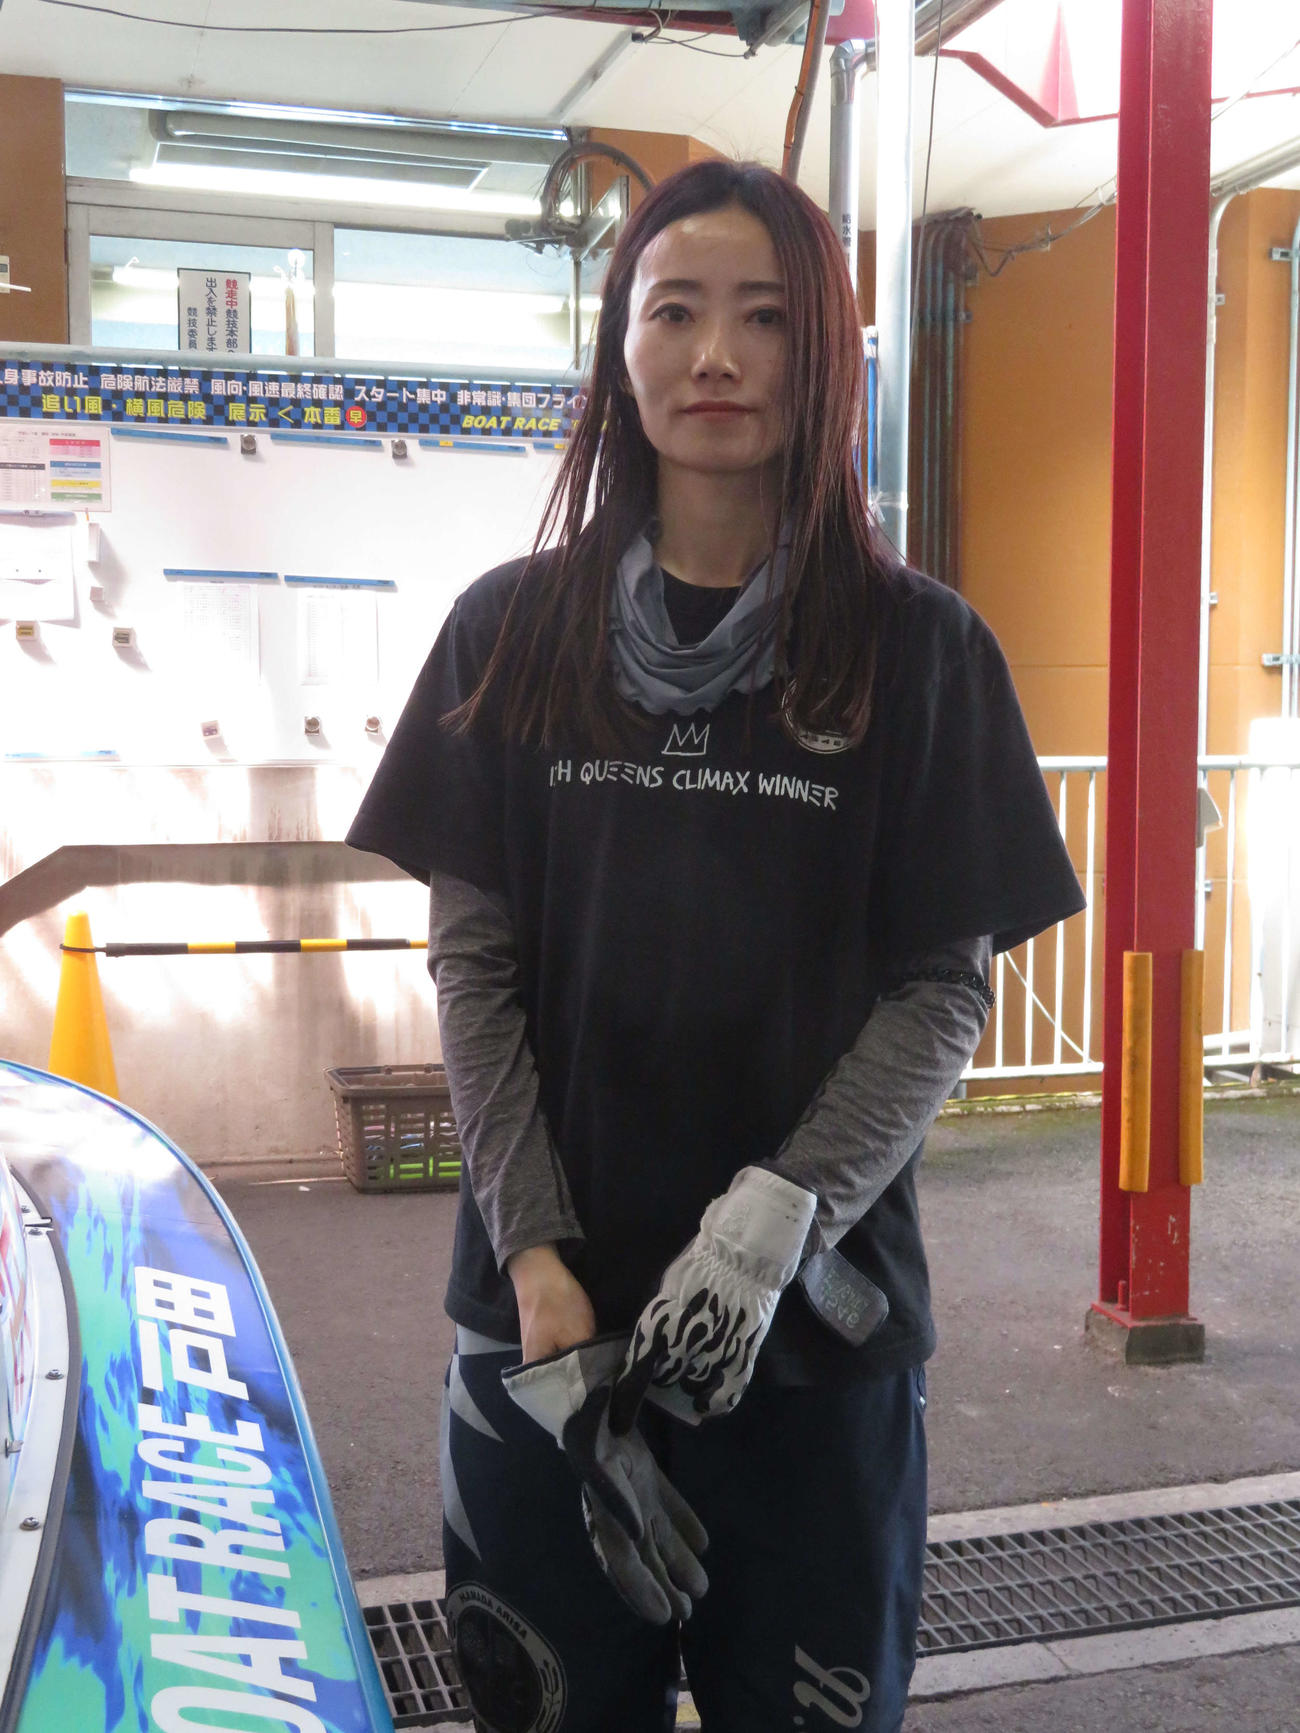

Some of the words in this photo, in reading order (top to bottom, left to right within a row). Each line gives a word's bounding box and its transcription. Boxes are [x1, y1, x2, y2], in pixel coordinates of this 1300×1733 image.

[0, 368, 89, 389] 身事故防止
[100, 373, 200, 393] 危険航法厳禁
[354, 385, 447, 405] スタート集中
[228, 402, 267, 422] 展示
[303, 405, 342, 426] 本番
[461, 415, 510, 430] BOAT
[513, 417, 561, 431] RACE
[580, 760, 664, 788] QUEENS
[672, 767, 751, 796] CLIMAX
[758, 772, 840, 811] WINNER
[134, 1266, 250, 1400] 戸田
[137, 1403, 292, 1580] RACE
